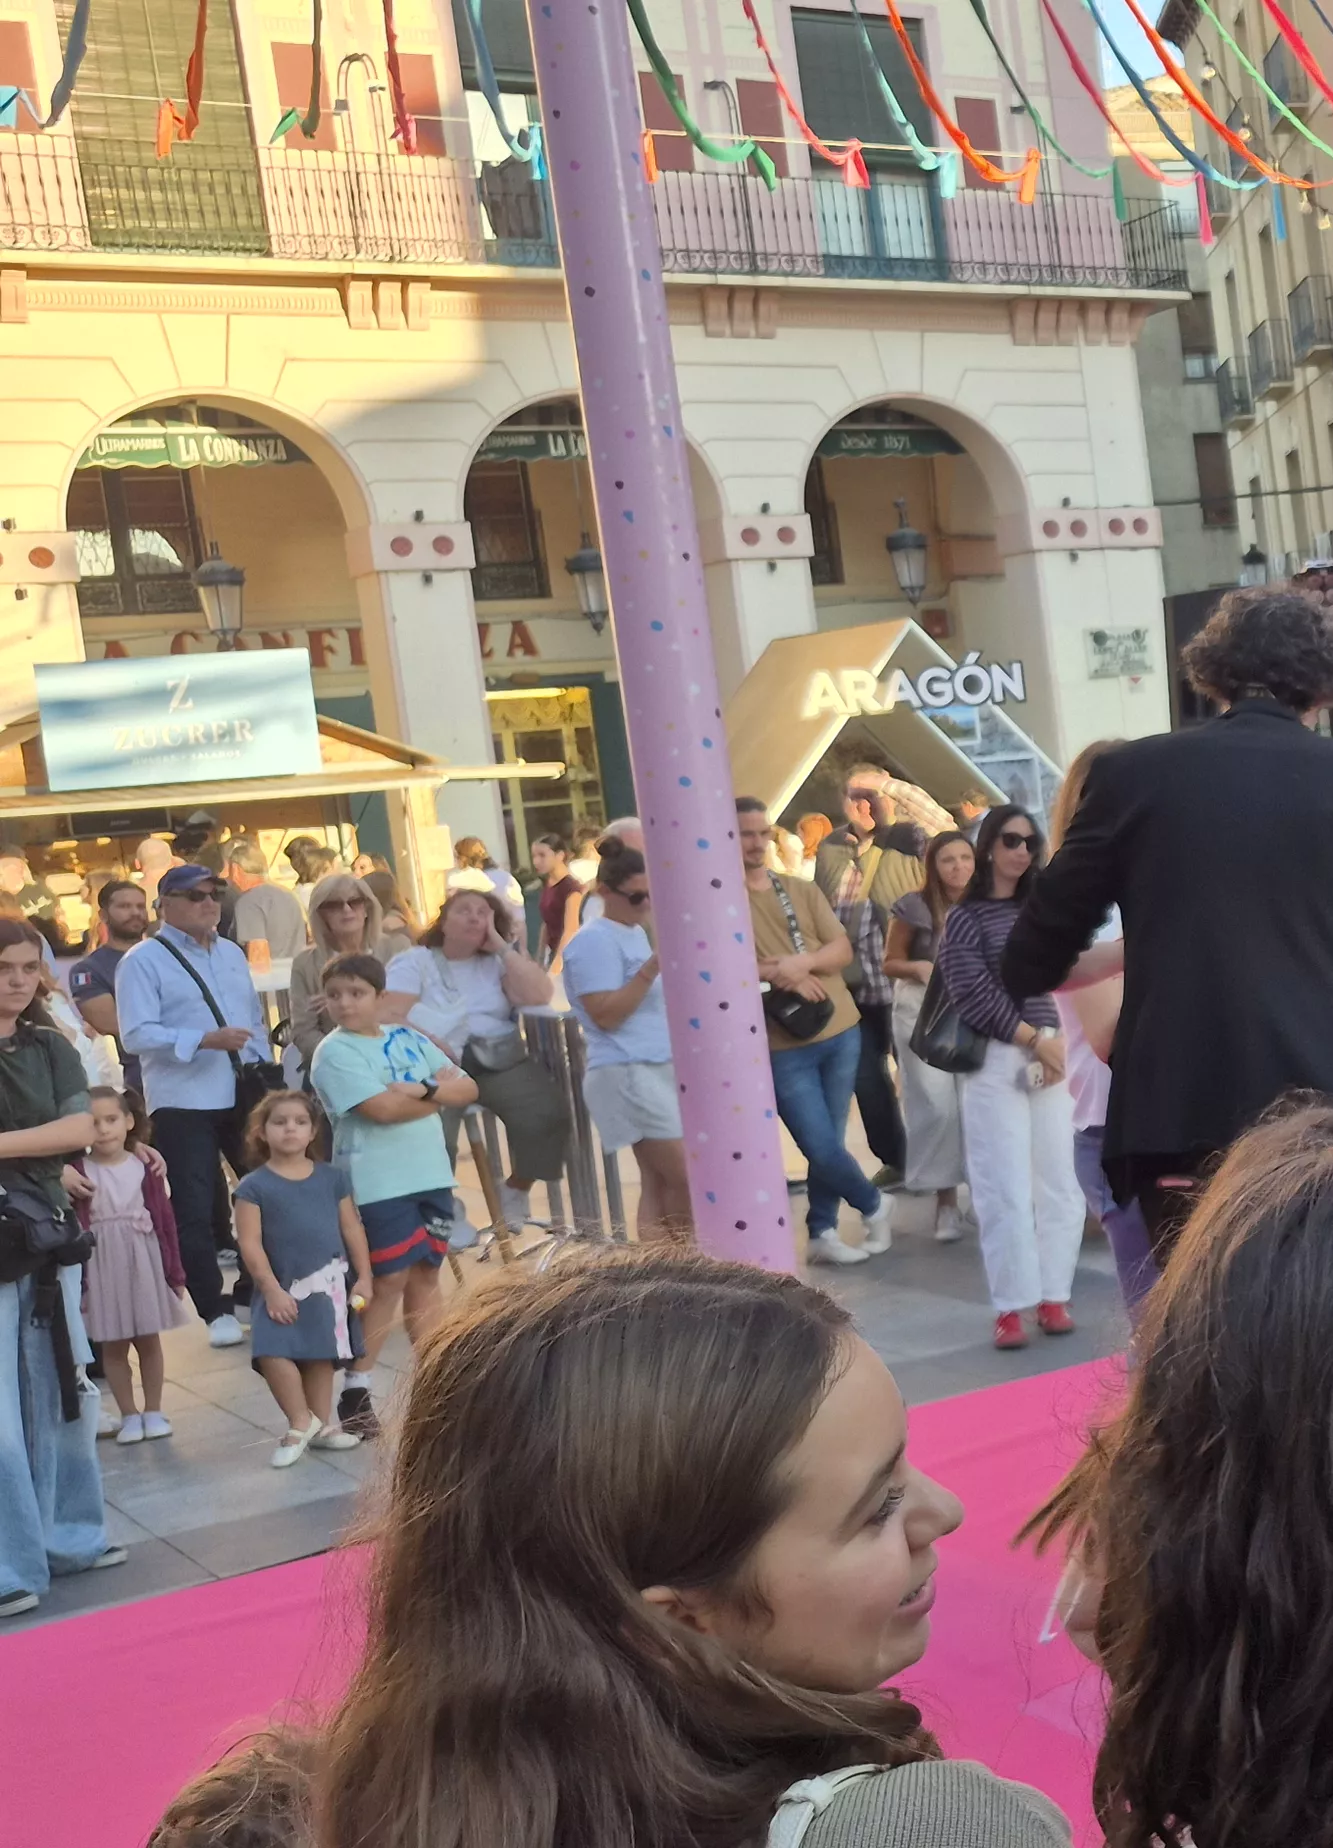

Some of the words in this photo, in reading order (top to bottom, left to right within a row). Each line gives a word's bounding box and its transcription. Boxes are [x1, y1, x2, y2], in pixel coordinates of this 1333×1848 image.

[178, 436, 200, 461] LA
[203, 434, 287, 461] CONFIANZA
[802, 651, 1027, 720] ARAGÓN
[112, 718, 255, 751] ZUCRER
